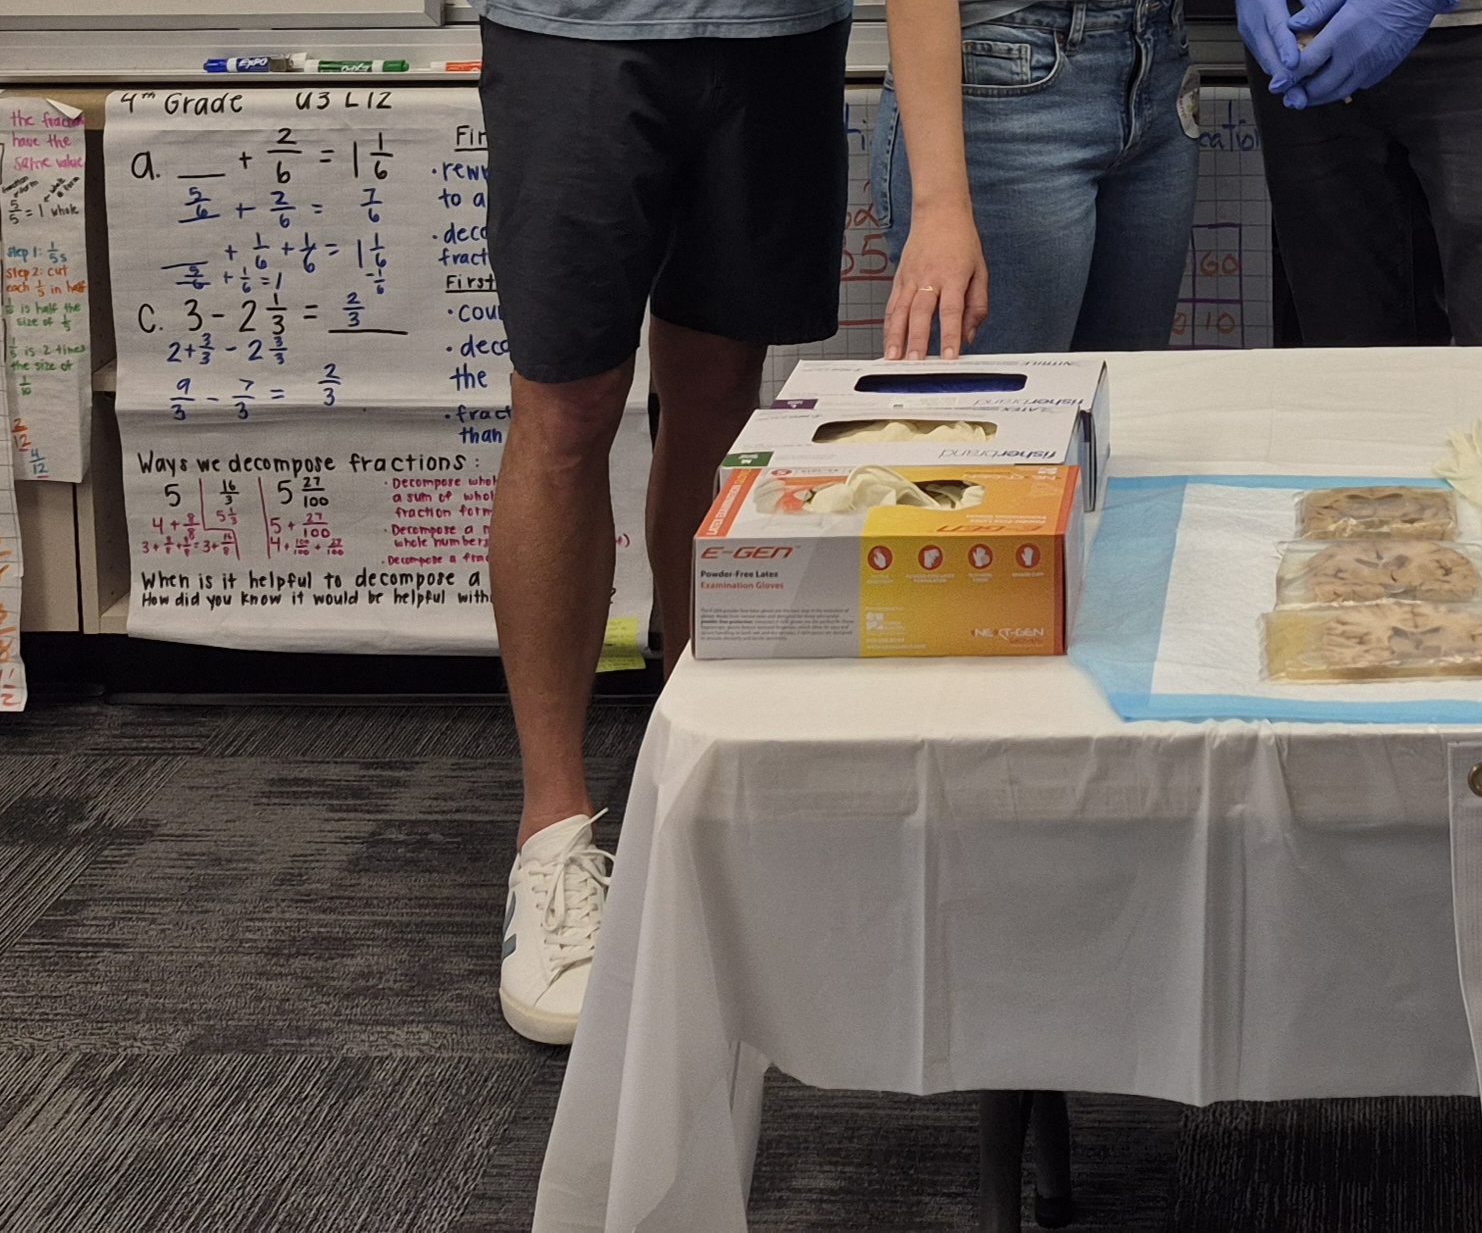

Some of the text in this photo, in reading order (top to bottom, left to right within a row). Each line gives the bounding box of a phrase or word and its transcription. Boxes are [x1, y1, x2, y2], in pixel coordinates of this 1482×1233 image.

[238, 59, 267, 68] EXPO
[165, 92, 243, 115] Grade
[12, 132, 72, 148] have the
[15, 156, 50, 169] same
[939, 448, 1057, 460] fisherbrand
[138, 452, 479, 477] Ways we decompose fractions:
[393, 478, 461, 490] Decompose
[396, 507, 451, 518] fraction
[701, 546, 793, 559] E-GEN
[141, 567, 480, 590] When is it helpful to decompose a
[141, 589, 446, 609] How did you know it would be helpful
